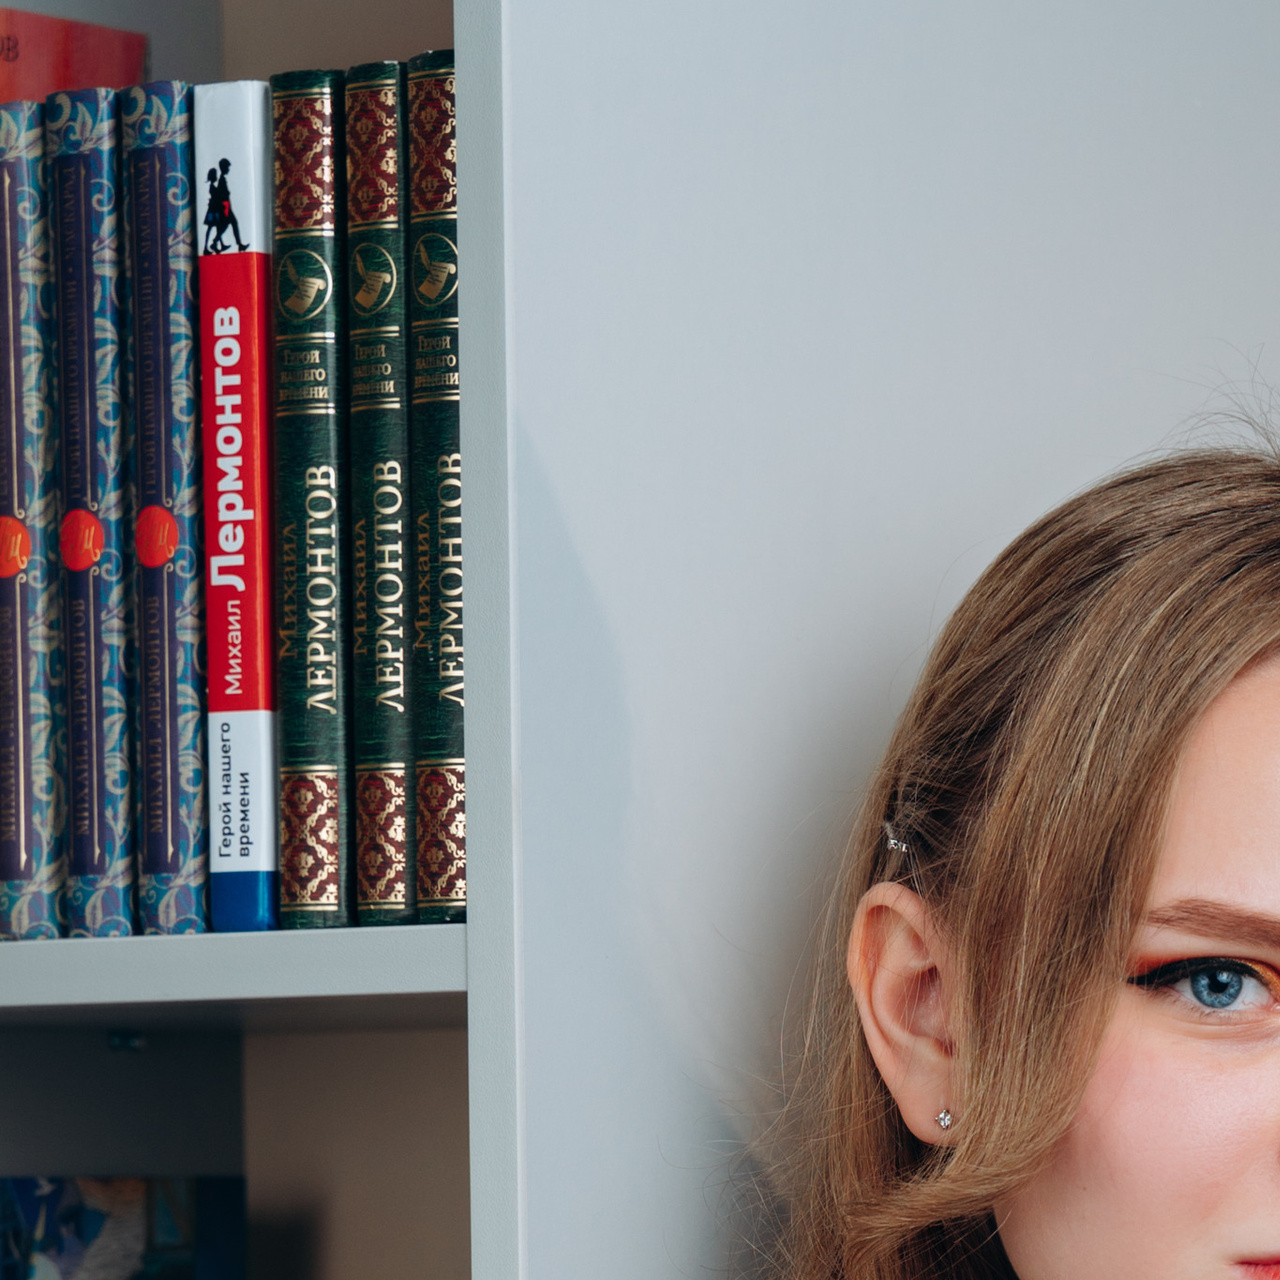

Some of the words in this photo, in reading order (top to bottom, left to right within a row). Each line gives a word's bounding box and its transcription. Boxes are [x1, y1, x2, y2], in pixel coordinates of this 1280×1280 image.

[210, 306, 254, 592] Лермонтов
[278, 521, 297, 660] Михаил
[305, 465, 338, 714] ЛЕРМОНТОВ
[353, 518, 367, 656] Михаил
[373, 460, 405, 712] ЛЕРМОНТОВ
[414, 512, 431, 650] Михаил
[437, 453, 465, 706] ЛЕРМОНТОВ
[72, 598, 88, 731] ЛЕРМОНТОВ
[146, 595, 162, 728] ЛЕРМОНТОВ
[224, 600, 243, 695] Михаил
[74, 739, 90, 836] МИХАИЛ
[149, 737, 164, 833] МИХАИЛ
[220, 722, 232, 795] нашего
[240, 772, 253, 857] времени
[218, 801, 235, 858] Герой
